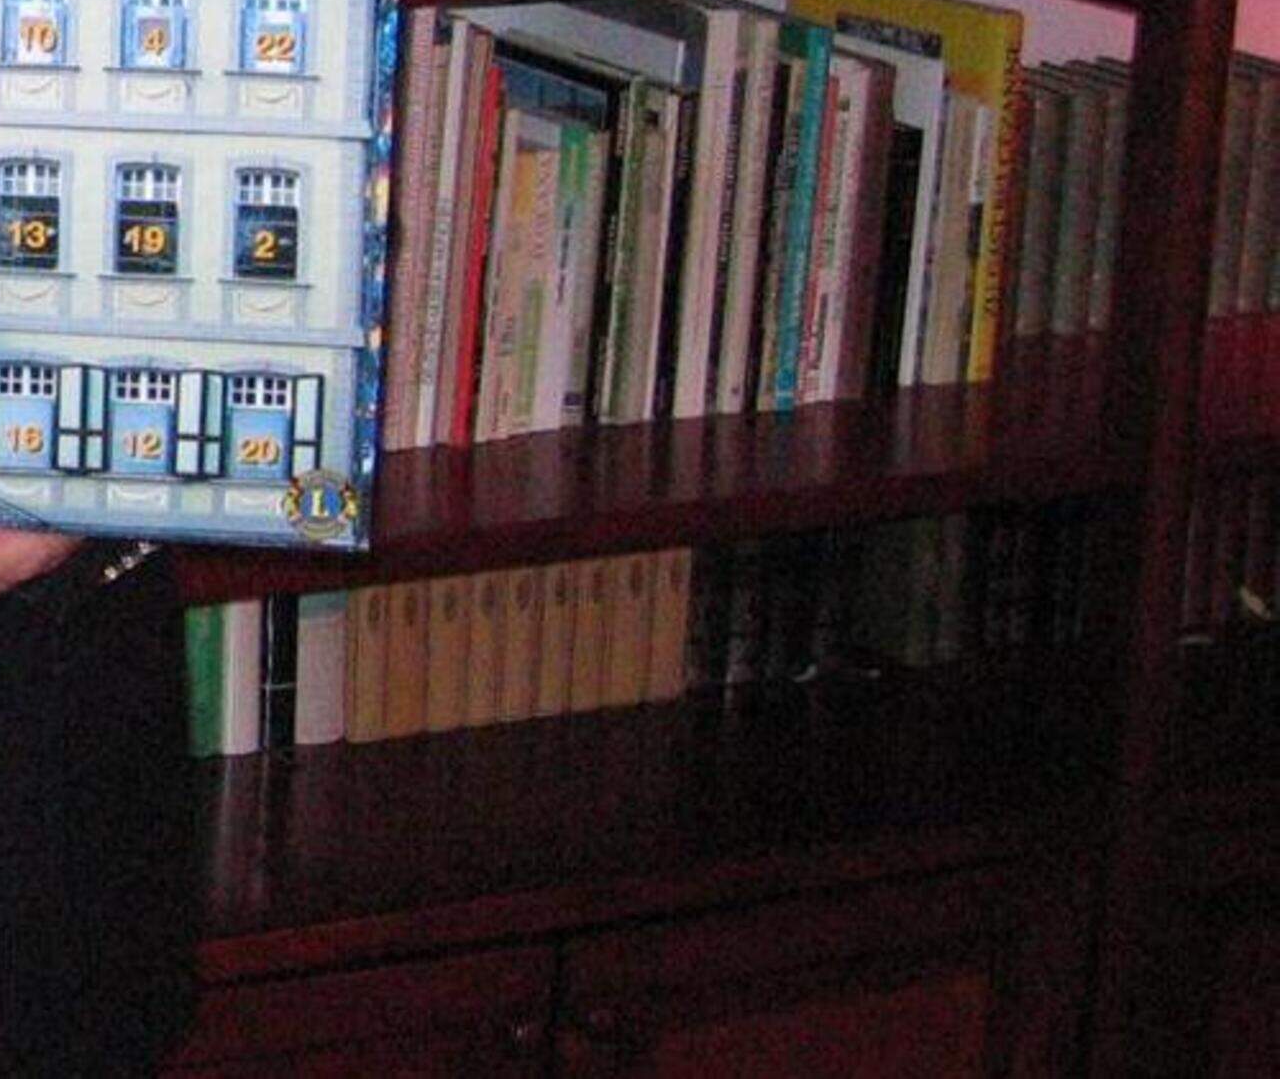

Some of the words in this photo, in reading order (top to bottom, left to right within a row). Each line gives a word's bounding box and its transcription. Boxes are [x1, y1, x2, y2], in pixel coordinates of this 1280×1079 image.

[20, 24, 58, 54] 10
[143, 28, 167, 55] 4
[255, 32, 296, 62] 22
[8, 221, 48, 249] 13
[124, 224, 166, 254] 19
[253, 232, 277, 259] 2
[6, 427, 44, 454] 16
[122, 430, 162, 459] 12
[238, 437, 278, 465] 20
